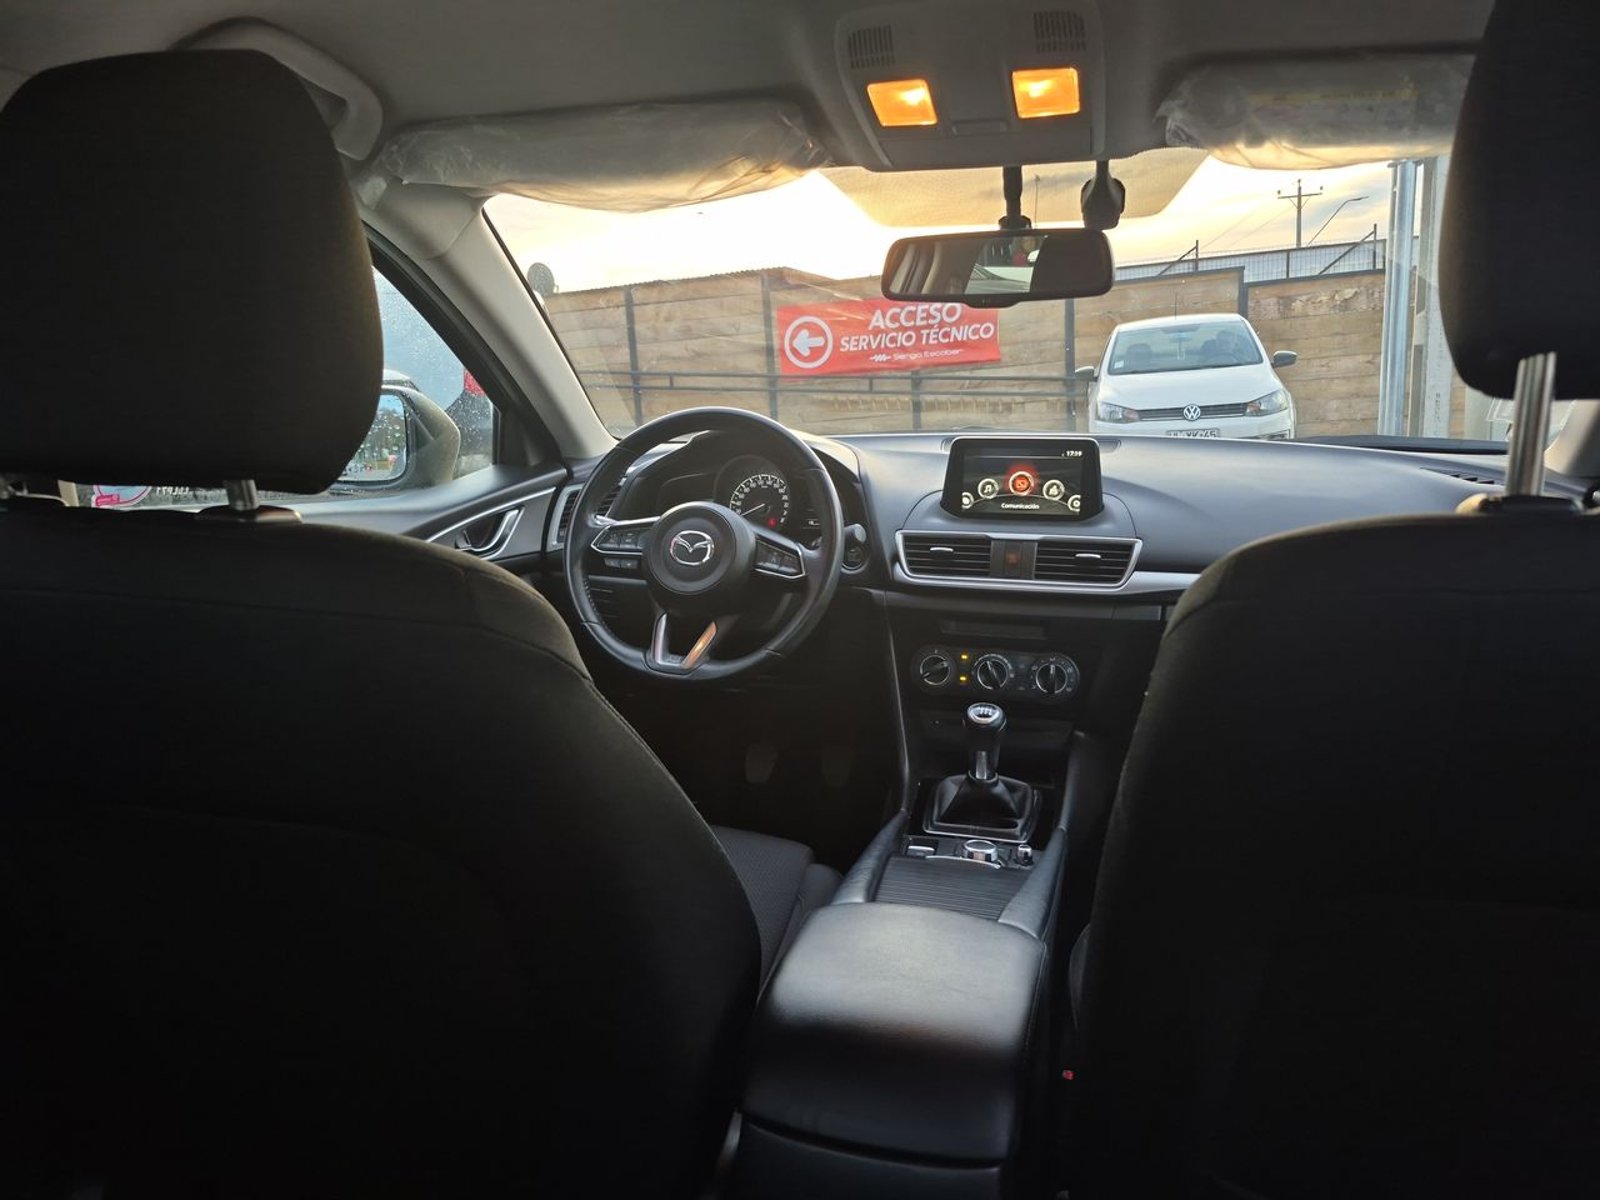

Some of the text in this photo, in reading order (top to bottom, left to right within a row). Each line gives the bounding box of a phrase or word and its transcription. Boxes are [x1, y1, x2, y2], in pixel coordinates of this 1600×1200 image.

[868, 302, 962, 330] ACCESO
[839, 322, 995, 352] SERVICIO TÉCNICO
